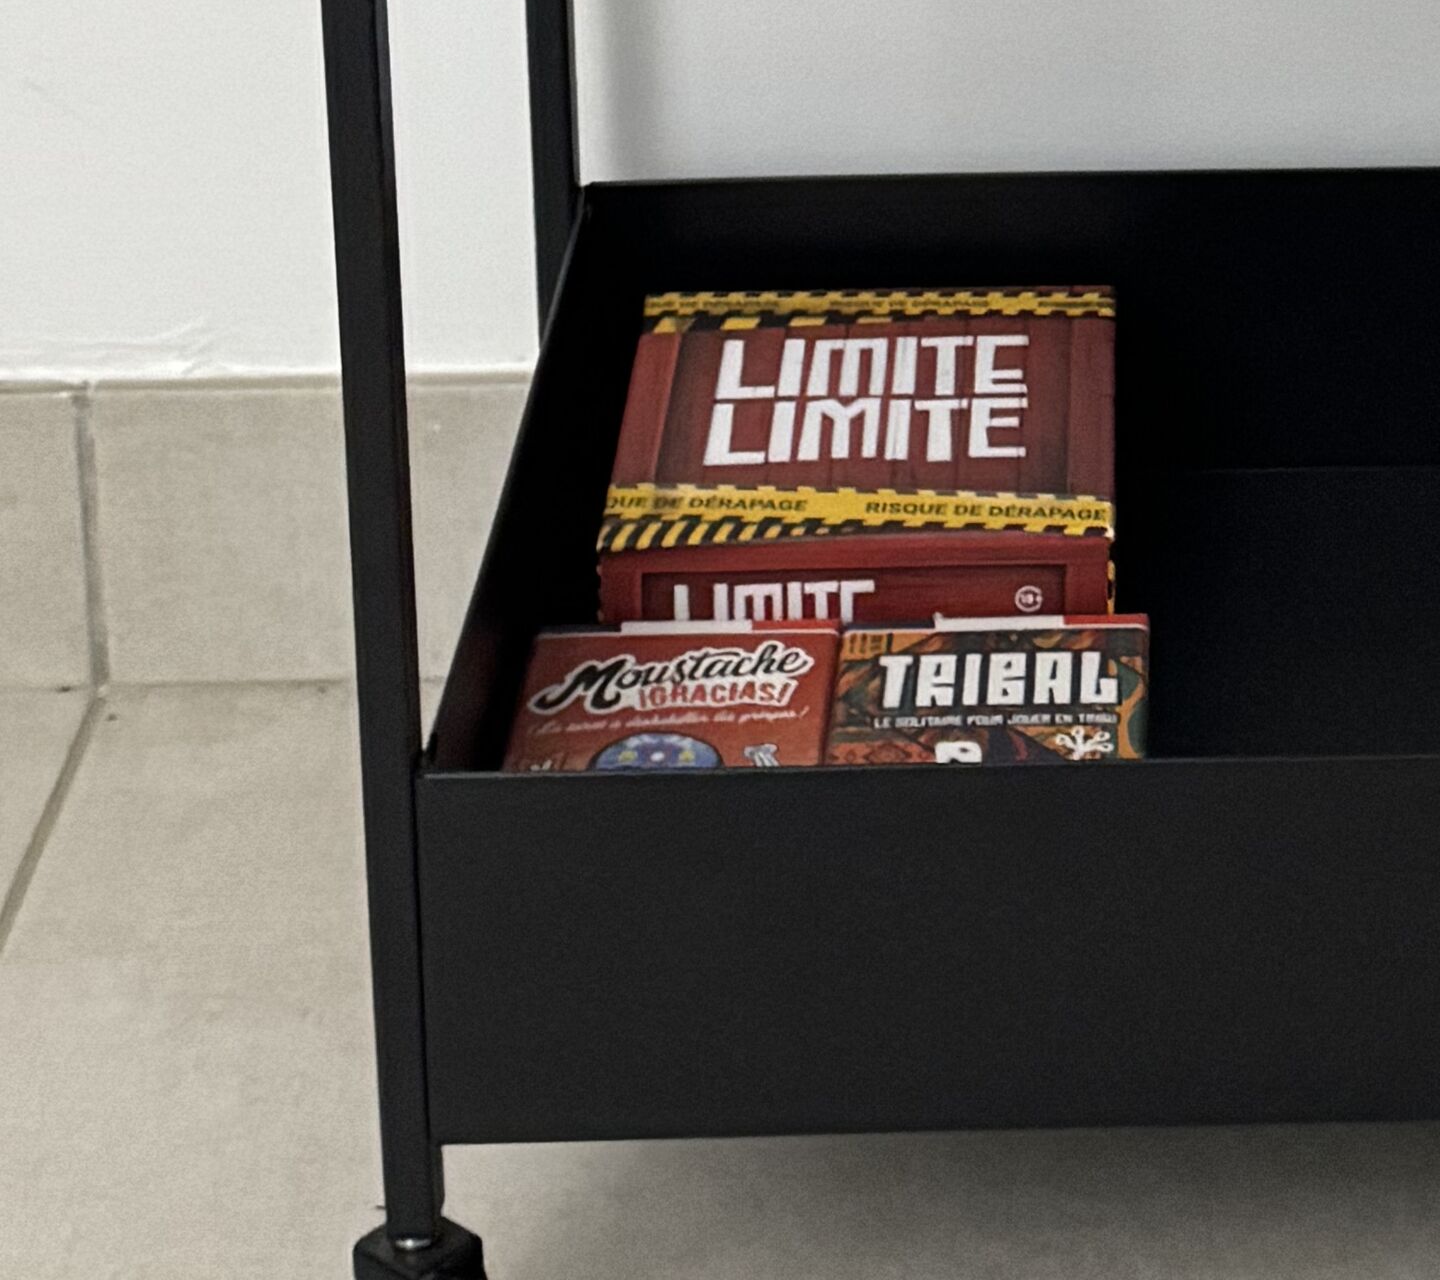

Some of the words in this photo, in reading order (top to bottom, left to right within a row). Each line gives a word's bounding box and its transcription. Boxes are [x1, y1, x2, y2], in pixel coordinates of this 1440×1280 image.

[715, 335, 1030, 400] LIMITE
[703, 397, 1029, 466] LIMITE
[653, 495, 684, 510] DE
[688, 495, 808, 512] DÉRAPAGE
[865, 502, 948, 517] RISQUE
[953, 503, 984, 517] DE
[988, 504, 1107, 520] DÉRAPAGE
[531, 643, 812, 711] Moustache
[879, 651, 1119, 708] TRIBAL
